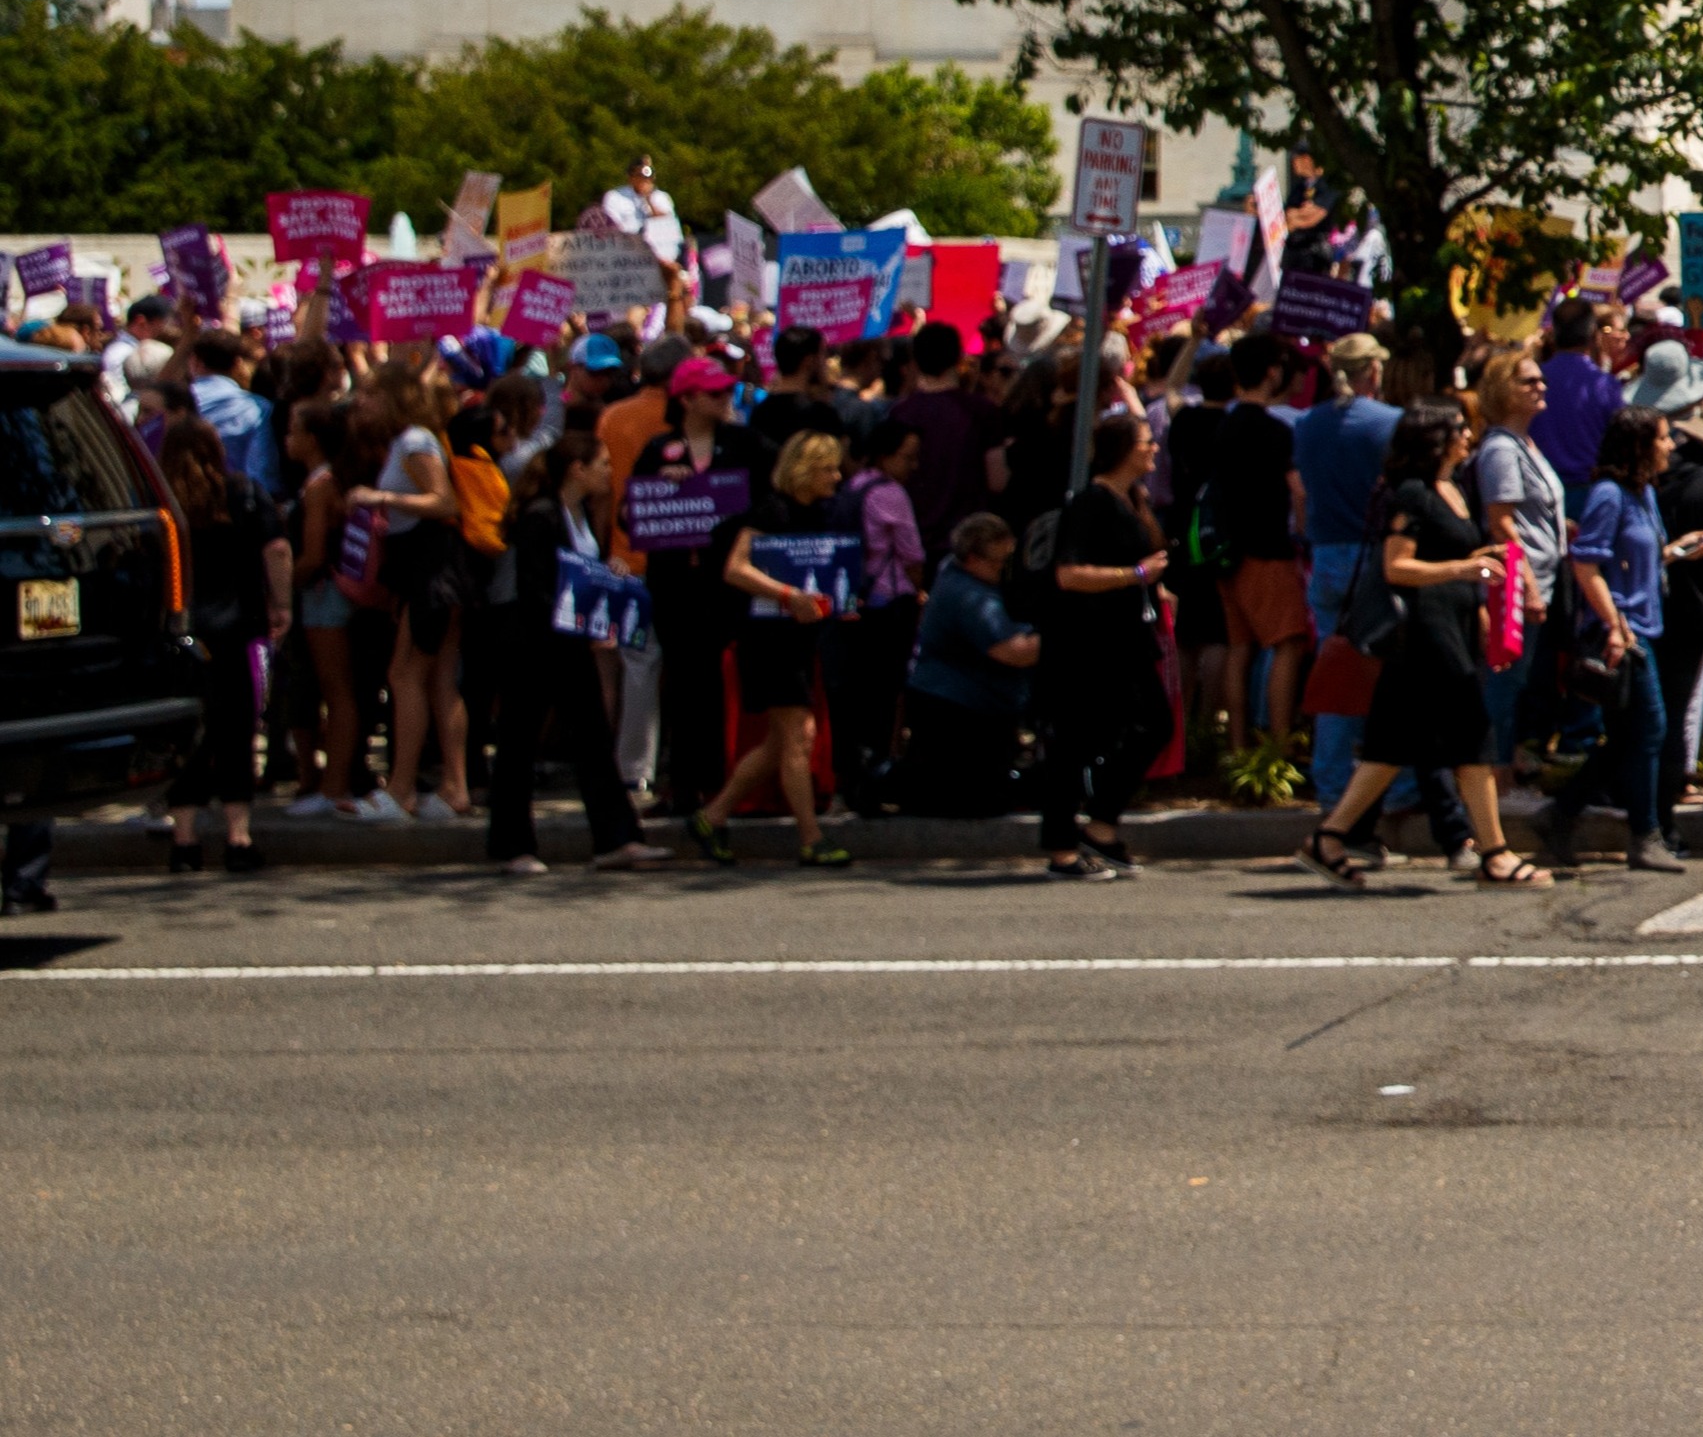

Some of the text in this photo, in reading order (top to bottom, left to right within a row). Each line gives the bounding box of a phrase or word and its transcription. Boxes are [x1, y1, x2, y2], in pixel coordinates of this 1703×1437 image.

[1099, 129, 1125, 150] NO
[1083, 150, 1138, 175] PARKING
[389, 274, 460, 288] PROTECT
[631, 481, 679, 498] STOP
[632, 495, 715, 515] BANNING
